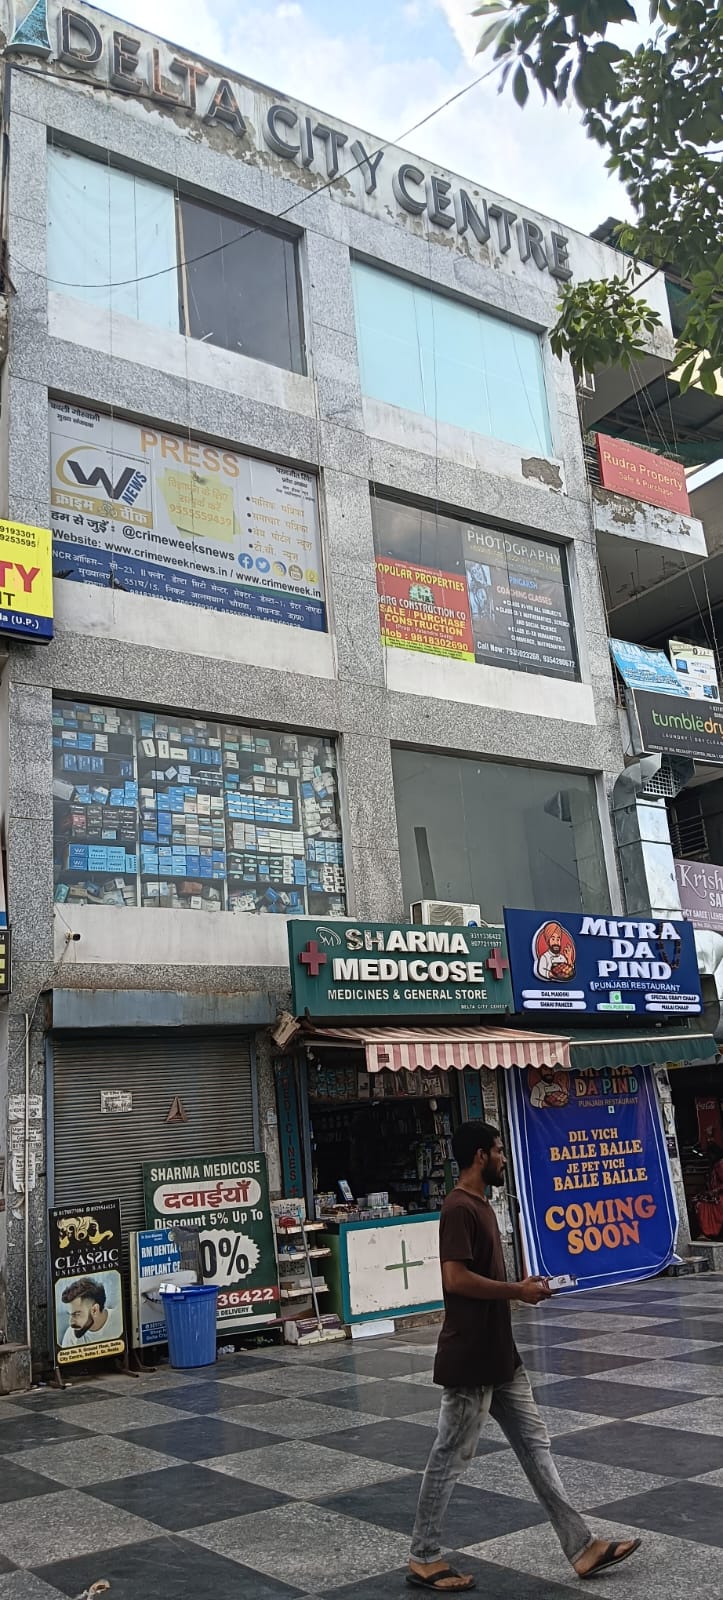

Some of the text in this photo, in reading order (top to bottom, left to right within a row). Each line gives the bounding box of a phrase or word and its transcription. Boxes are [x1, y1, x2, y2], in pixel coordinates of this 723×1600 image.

[57, 7, 574, 281] DELTA CITY CENTRE
[140, 429, 240, 478] PRESS
[602, 450, 636, 473] Rudra
[639, 464, 684, 491] Property
[121, 472, 148, 506] NEWS
[642, 480, 674, 497] Purchase
[55, 492, 95, 512] क्राइम
[50, 510, 70, 522] हम
[72, 514, 84, 526] से
[122, 525, 235, 561] @crimeweeksnews
[52, 550, 72, 561] NCR
[467, 530, 560, 566] PHOTOGRAPHY
[52, 528, 102, 548] Website:
[104, 542, 228, 577] www.crimeweeknews.in
[236, 572, 322, 598] www.crimeweek.in
[415, 572, 465, 592] PROPERTIES
[0, 590, 16, 606] T
[378, 594, 467, 622] ARG CONSTRUCTION CO
[527, 593, 552, 606] CLASSES
[11, 614, 40, 630] (U.P.)
[379, 604, 406, 617] SALE
[414, 610, 466, 629] PURCHASE
[385, 613, 463, 637] CONSTRUCTION
[380, 627, 402, 638] Mob
[410, 632, 469, 651] 9818302690
[477, 641, 490, 651] Call
[662, 732, 688, 740] LAUNDRY
[579, 917, 681, 940] MITRA
[345, 928, 470, 954] SHARMA
[611, 938, 656, 960] DA
[332, 958, 485, 983] MEDICOSE
[597, 960, 672, 980] PIND
[328, 989, 488, 1000] MEDICINES & GENERAL STORE
[592, 981, 681, 992] PUNJABI RESTAURANT
[574, 1076, 638, 1098] DA PIND
[604, 1096, 638, 1106] RESTAURANT
[568, 1127, 618, 1142] DIL VICH
[550, 1140, 644, 1162] BALLE BALLE
[150, 1160, 261, 1182] SHARMA MEDICOSE
[566, 1158, 625, 1174] JE PET VICH
[553, 1167, 648, 1192] BALLE BALLE
[163, 1178, 252, 1209] दवाईयाँ
[154, 1216, 206, 1231] Discount
[210, 1212, 228, 1226] 5%
[232, 1210, 248, 1224] Up
[250, 1208, 264, 1221] To
[544, 1194, 657, 1232] COMING
[567, 1220, 640, 1254] SOON
[54, 1248, 119, 1270] CLASSIC
[153, 1243, 178, 1256] DENTAL
[56, 1262, 119, 1276] UNISEX SALON
[142, 1262, 172, 1278] IMPLANT
[220, 1307, 250, 1316] DELIVERY
